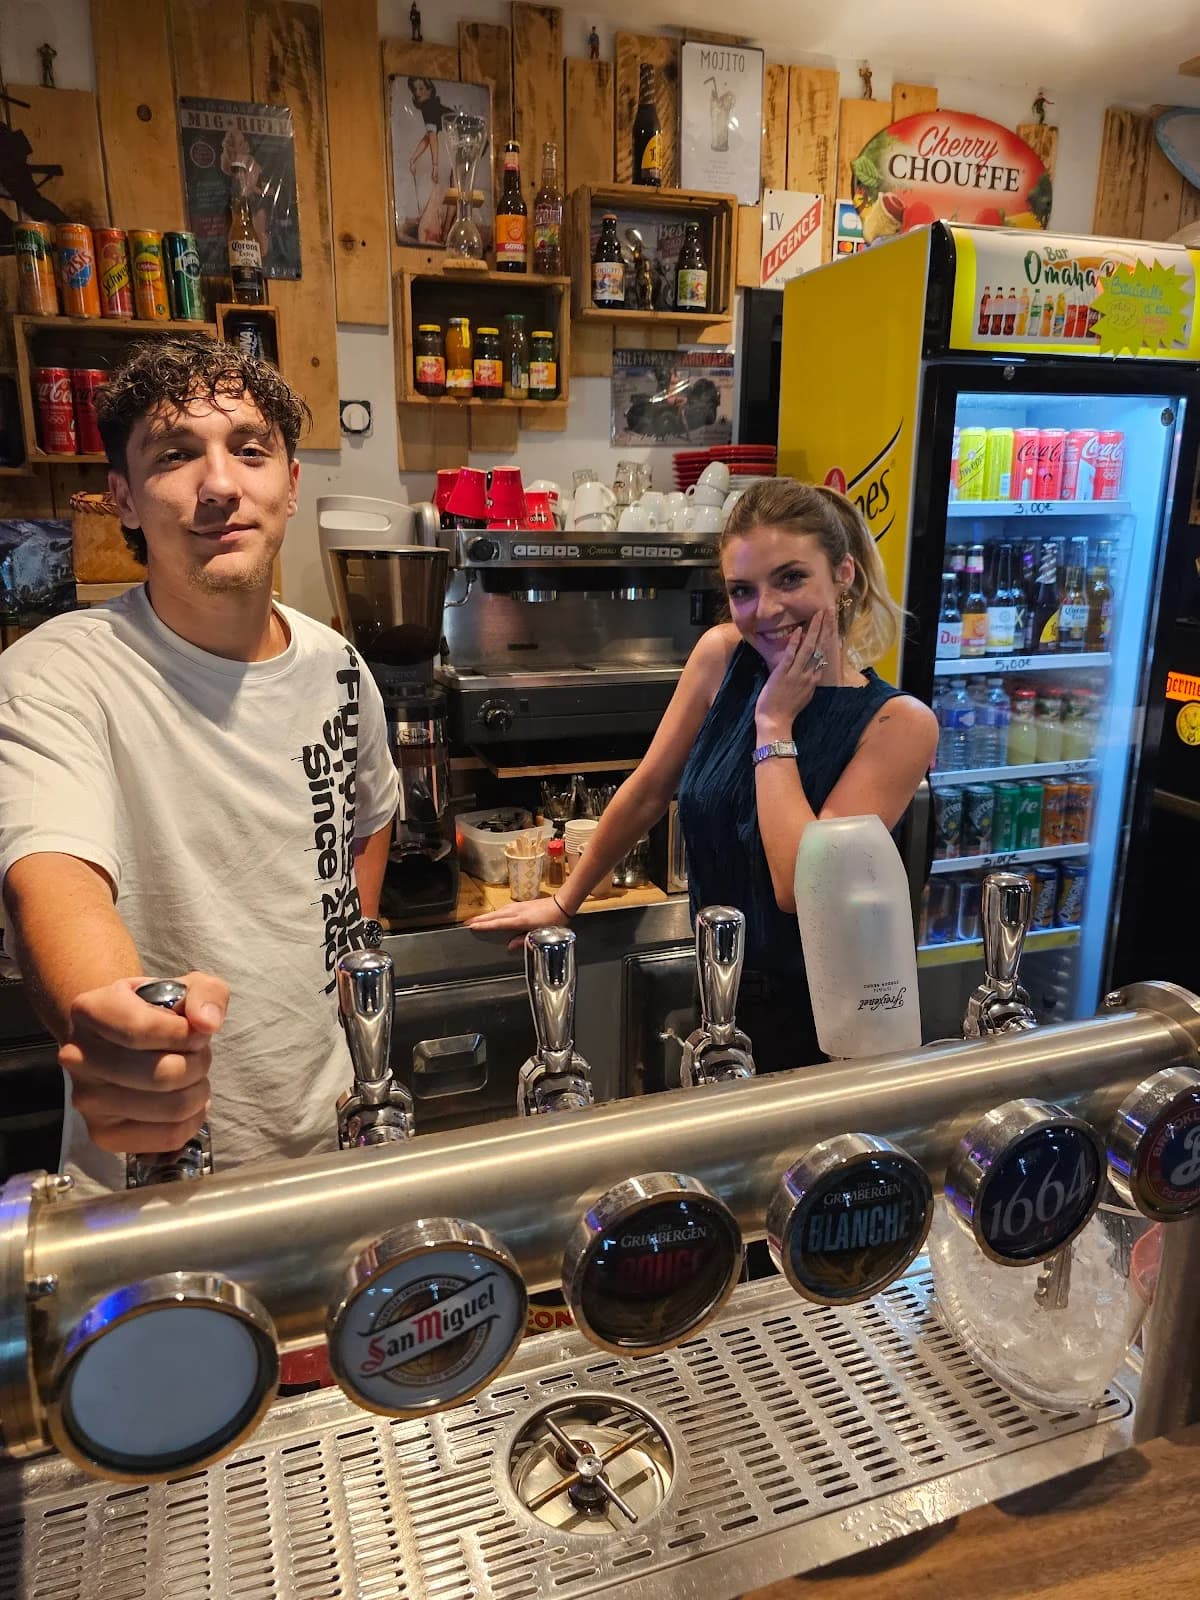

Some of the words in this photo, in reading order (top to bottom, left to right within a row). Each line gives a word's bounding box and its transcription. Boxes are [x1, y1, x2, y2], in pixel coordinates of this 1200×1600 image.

[700, 50, 745, 72] MOJITO
[918, 126, 998, 174] Cherry
[889, 154, 1020, 193] CHOUFFE
[769, 212, 784, 231] IV
[232, 240, 258, 251] Corona
[767, 207, 816, 280] LICENCE
[1045, 247, 1068, 262] Bar
[1024, 250, 1097, 291] Omaha
[614, 351, 665, 367] MILITARY
[682, 352, 732, 368] ARDWARE
[1014, 502, 1054, 516] 3,00€
[994, 658, 1033, 671] 5,00€
[302, 743, 338, 881] Since
[858, 987, 907, 1011] Freixenet
[989, 1150, 1091, 1241] 1664
[808, 1200, 912, 1253] BLANCHE
[360, 1328, 415, 1372] San
[411, 1282, 496, 1345] Miguel
